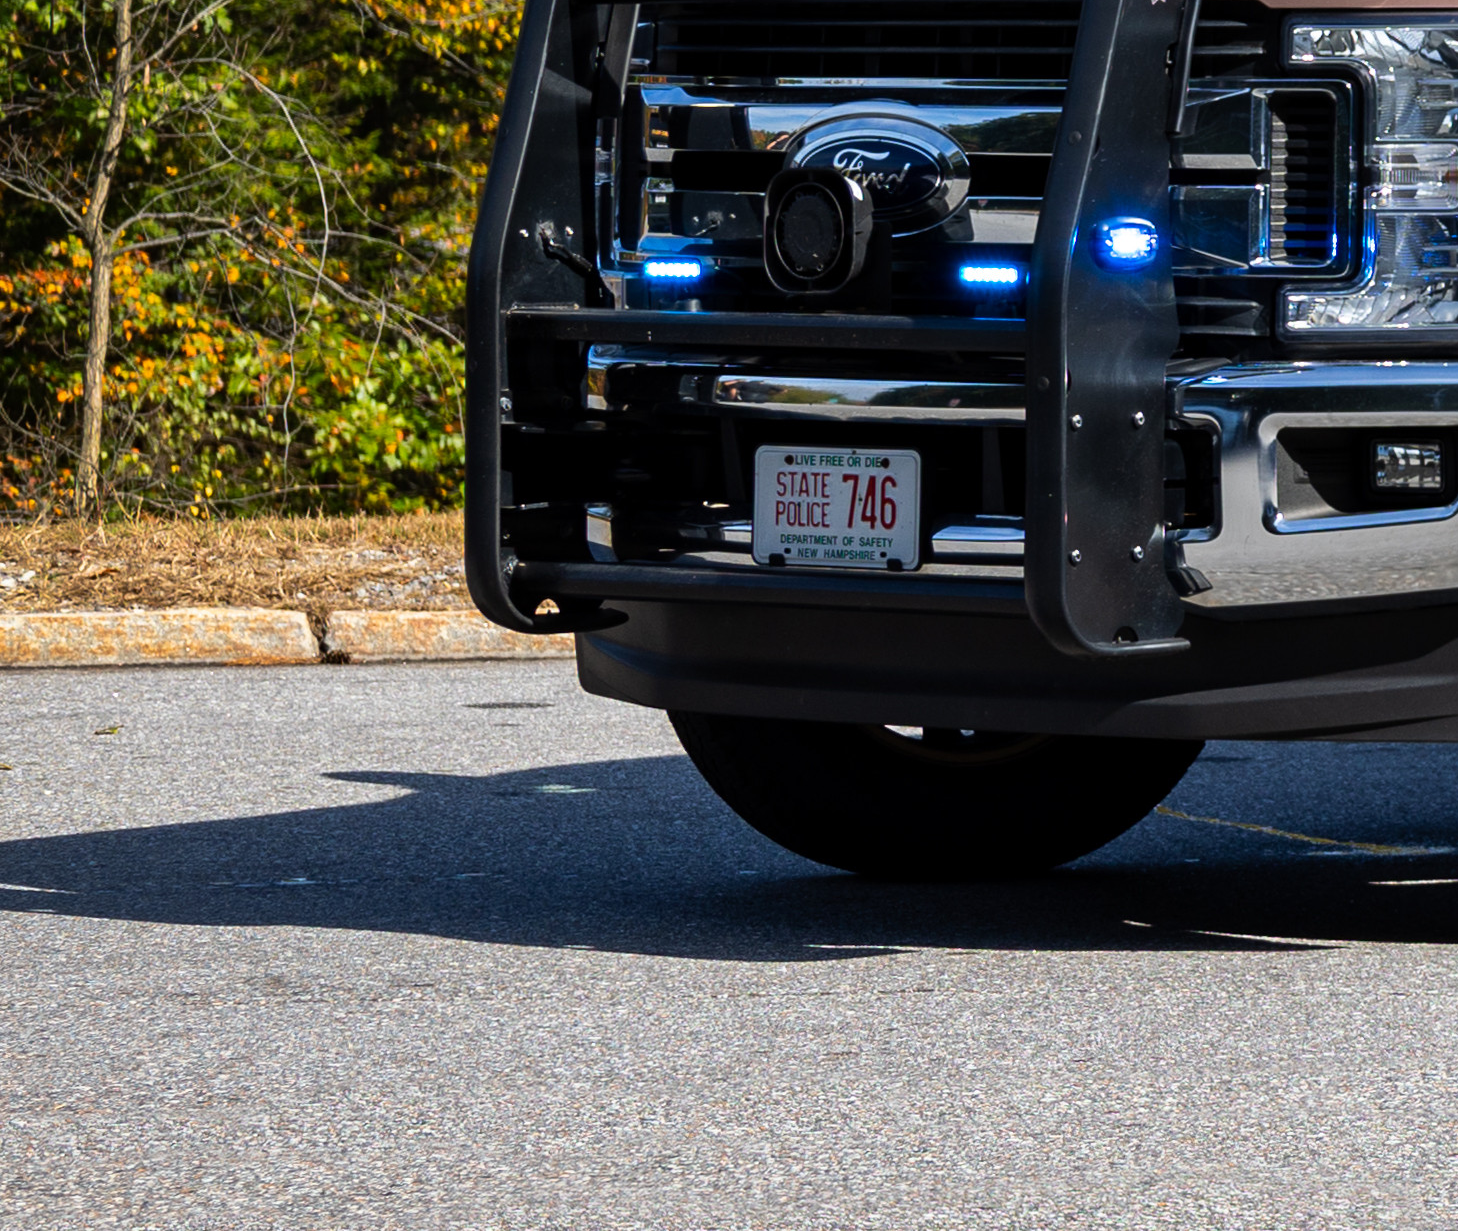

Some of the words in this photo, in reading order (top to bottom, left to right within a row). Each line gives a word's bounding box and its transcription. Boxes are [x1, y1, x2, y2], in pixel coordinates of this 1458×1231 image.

[832, 148, 912, 194] Ford
[795, 455, 817, 466] LIVE
[819, 456, 845, 467] FREE
[848, 456, 861, 468] OR
[865, 457, 882, 468] DIE
[776, 471, 831, 498] STATE
[775, 500, 831, 528] POLICE
[842, 474, 897, 530] 746
[780, 533, 838, 546] DEPARTMENT
[843, 536, 855, 546] OF
[859, 537, 894, 548] SAFETY
[797, 547, 818, 558] NEW
[823, 548, 876, 560] HAMPSHIRE
